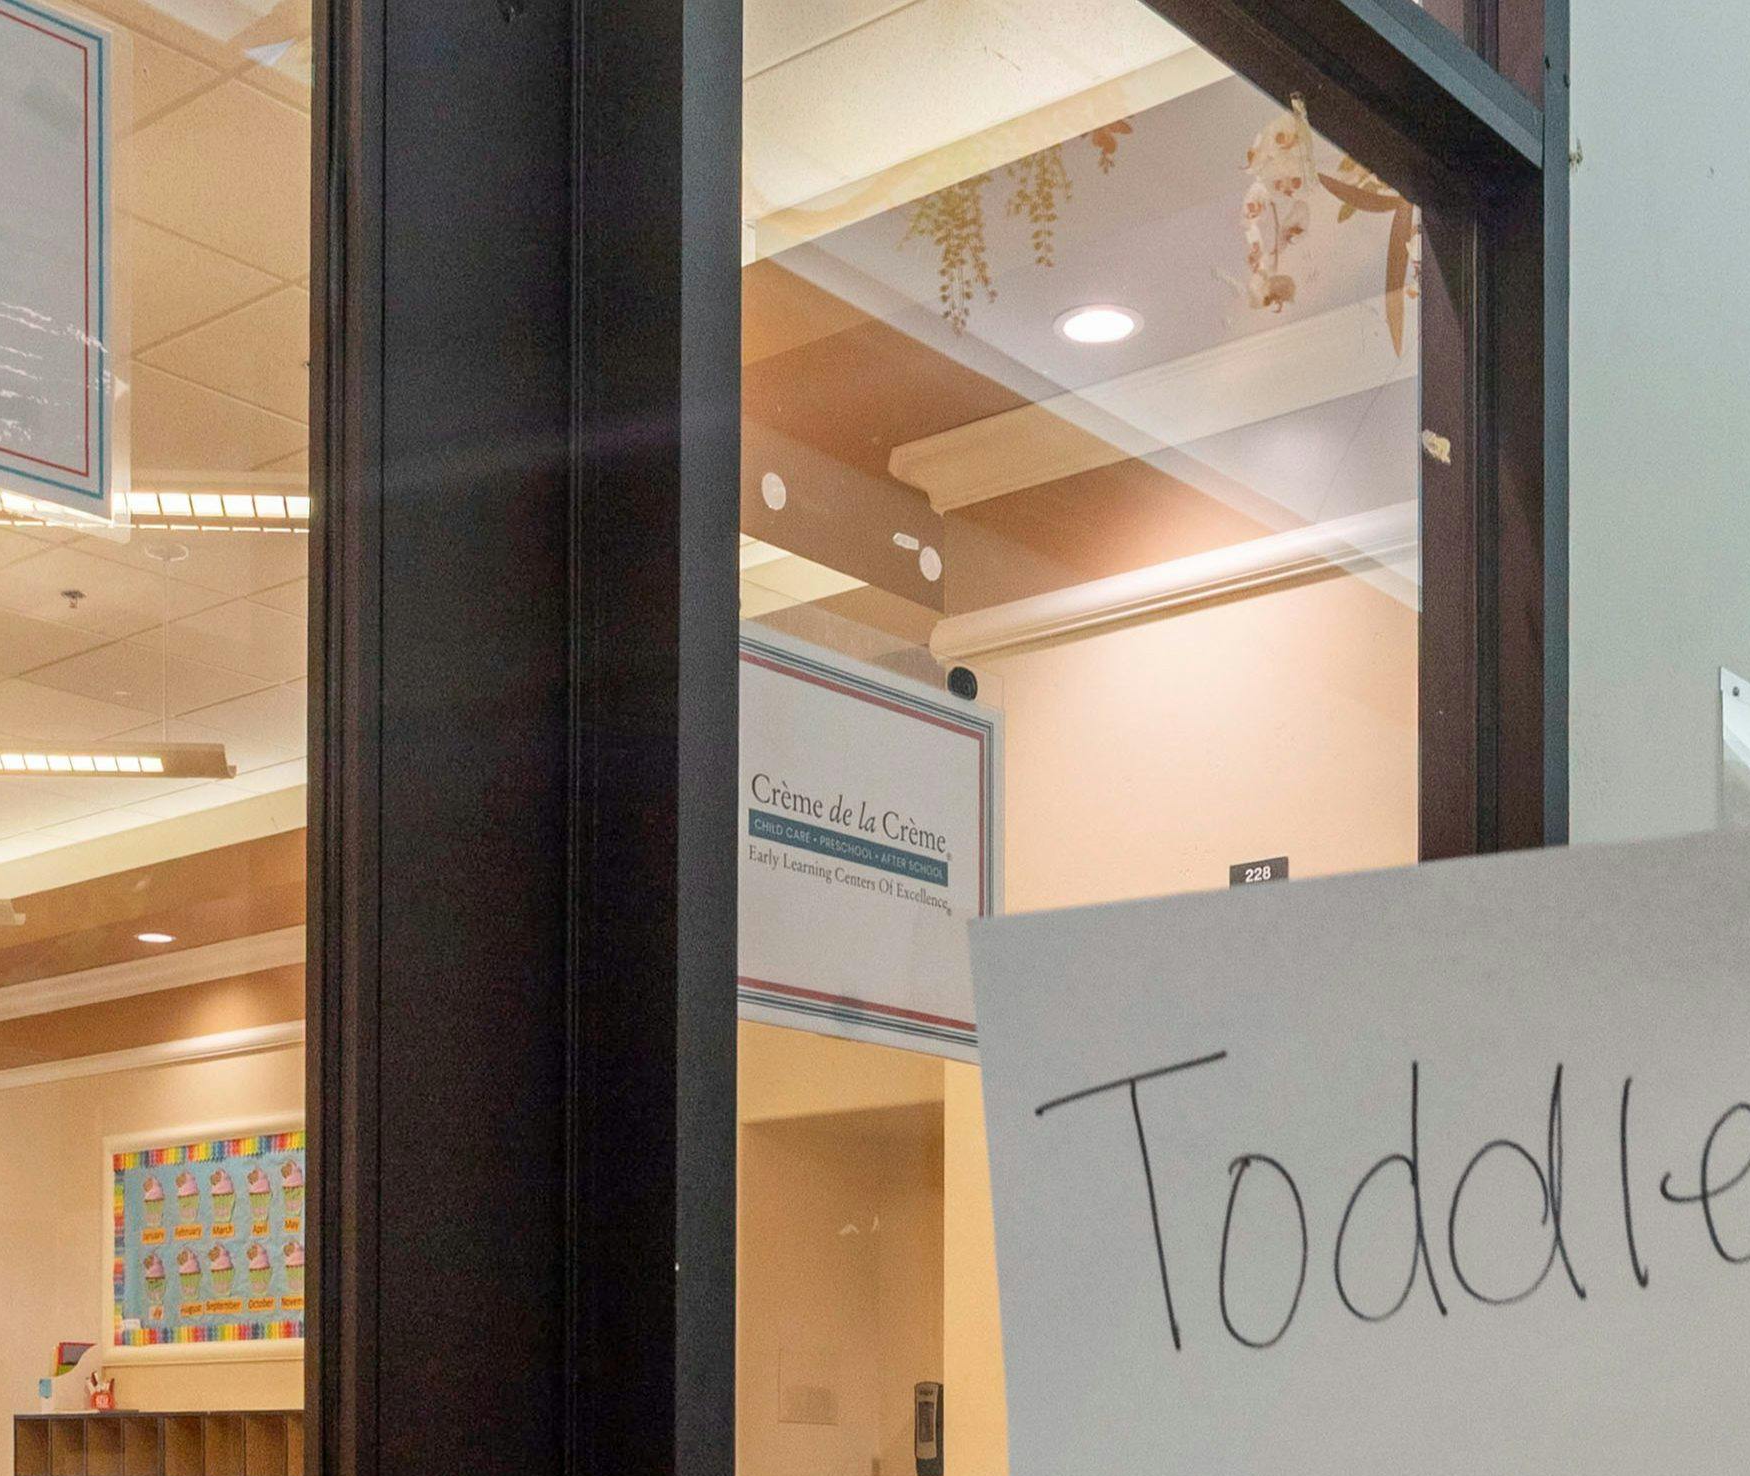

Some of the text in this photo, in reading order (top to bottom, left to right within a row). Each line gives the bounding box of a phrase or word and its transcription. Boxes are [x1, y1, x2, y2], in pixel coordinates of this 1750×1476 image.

[751, 773, 946, 853] Crème de la Crème
[749, 844, 949, 911] Early Learning Centers Of Excellence
[753, 818, 944, 880] CHILD CARE PRESCHOOL AFTER SCHOOL
[1245, 865, 1271, 883] 228
[284, 1218, 299, 1231] May
